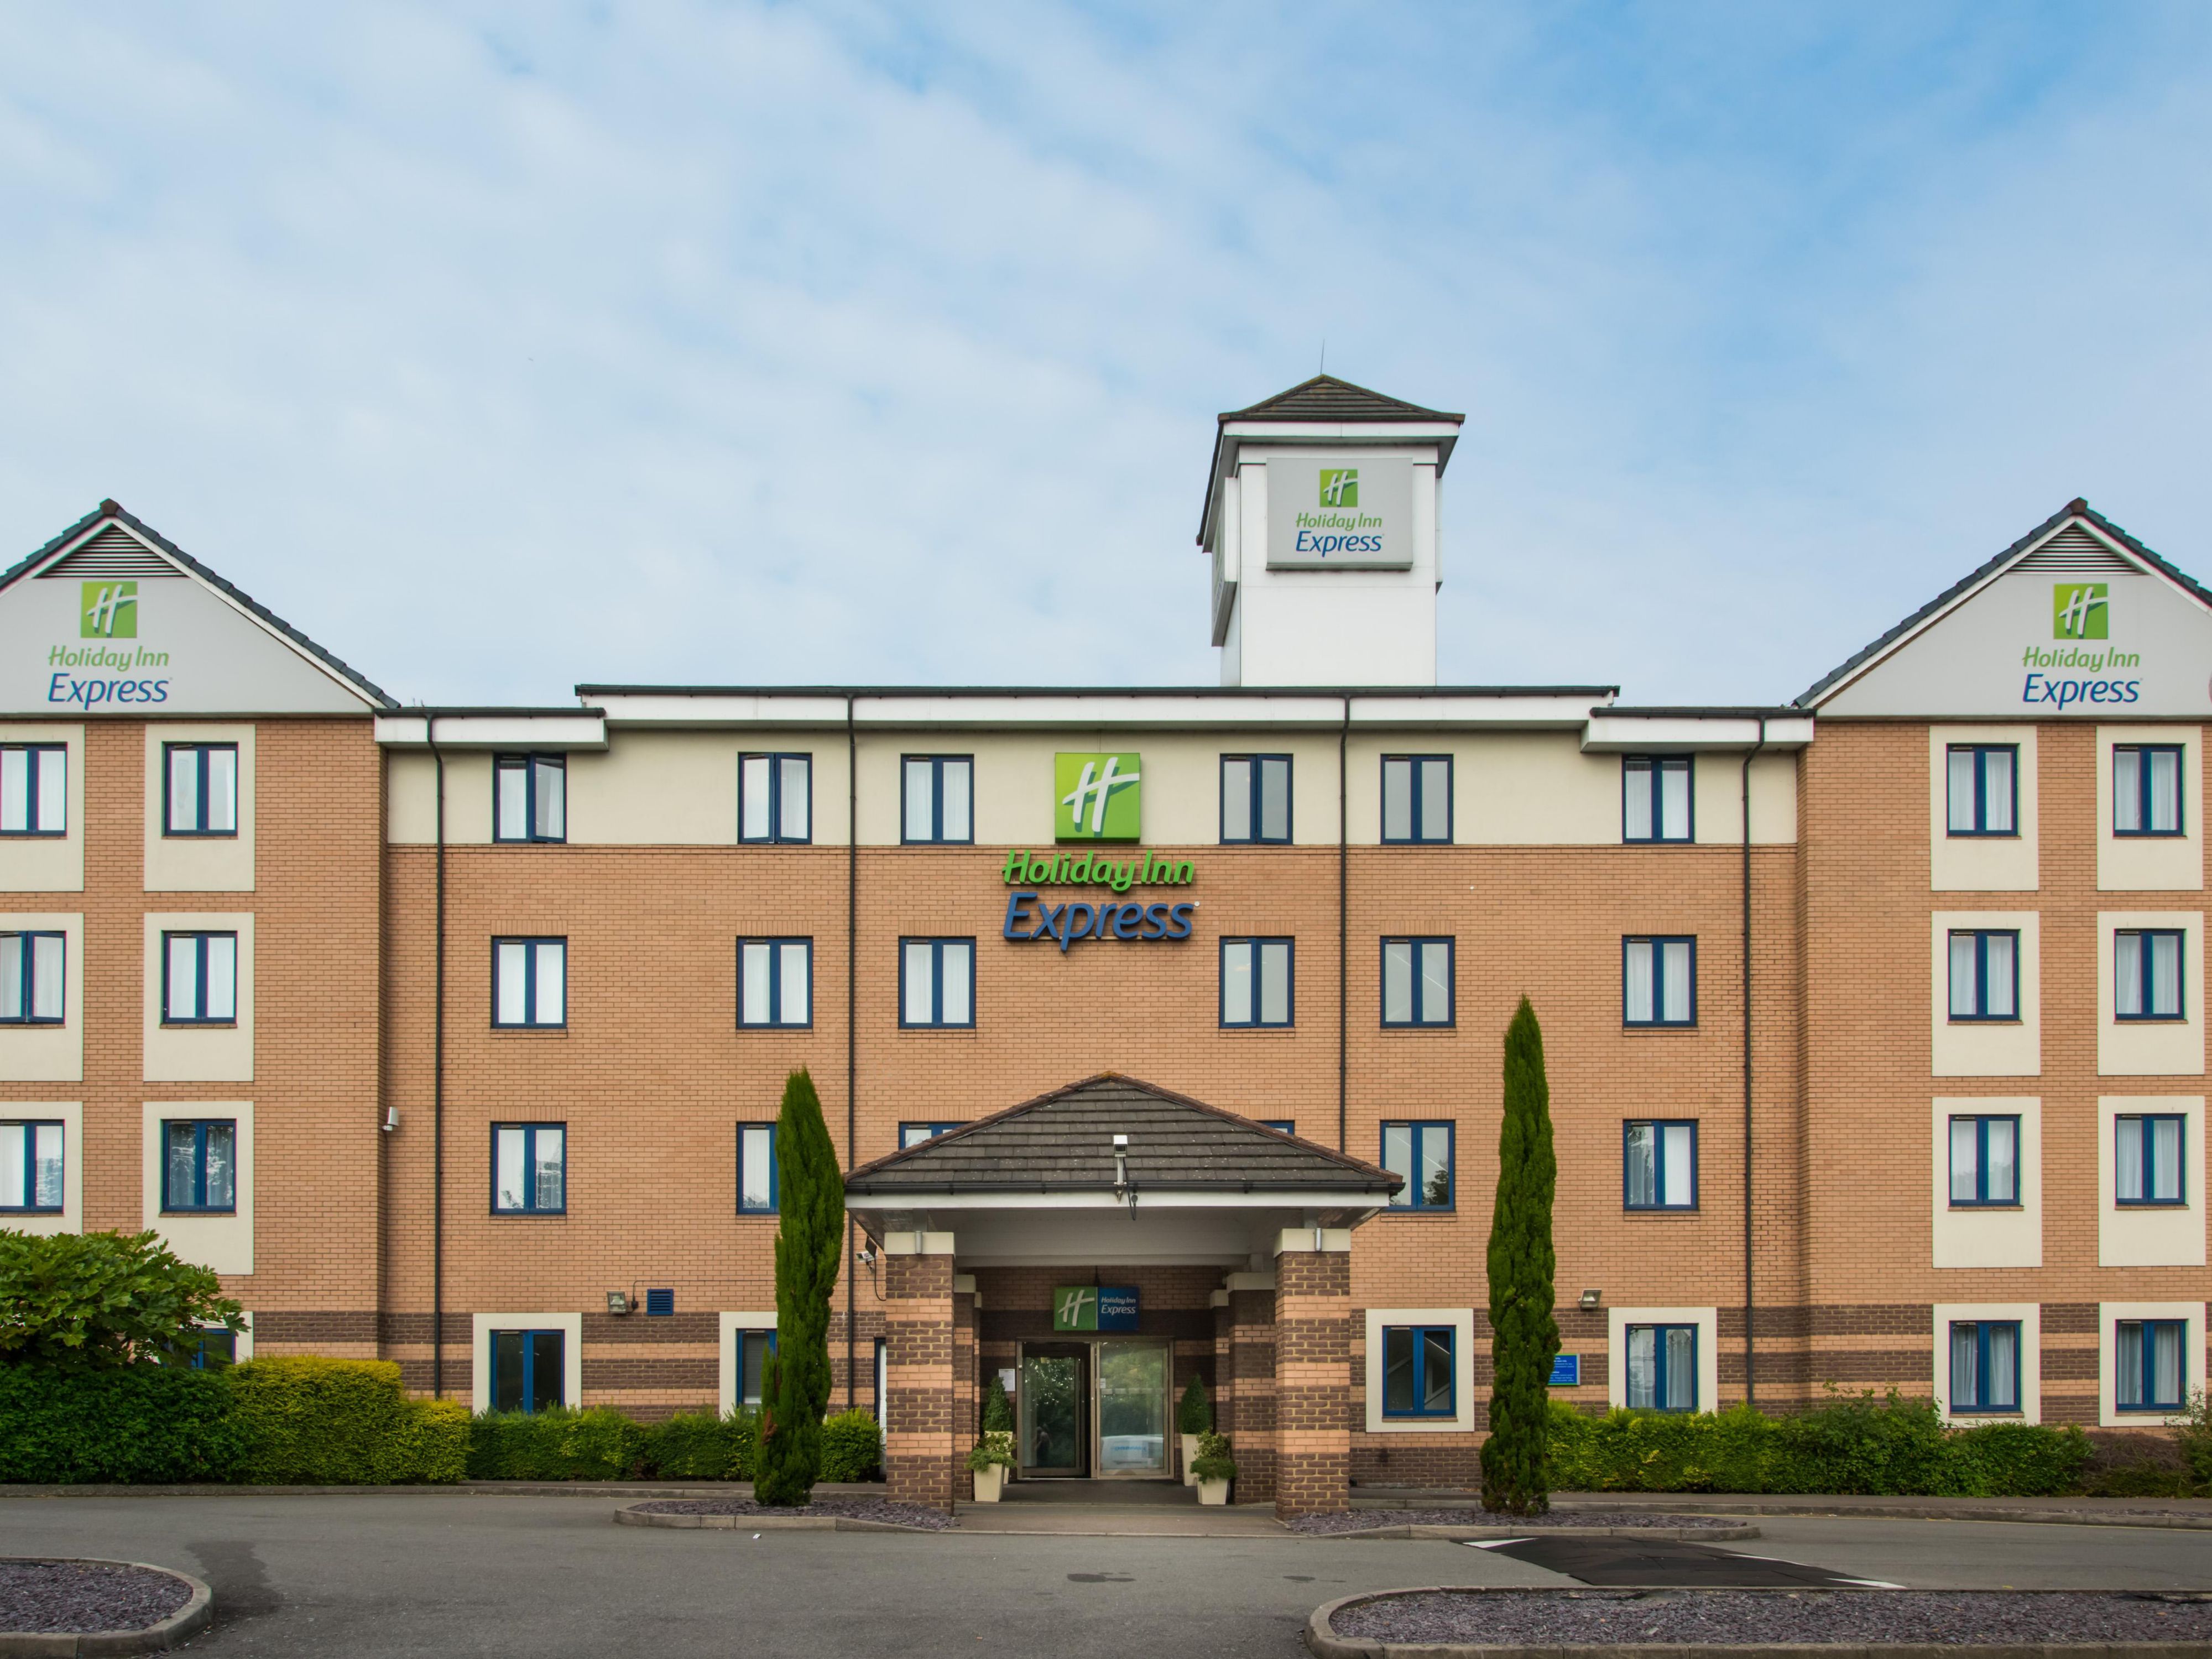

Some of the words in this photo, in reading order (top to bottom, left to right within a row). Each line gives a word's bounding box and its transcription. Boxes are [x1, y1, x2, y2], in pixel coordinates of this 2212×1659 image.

[1323, 471, 1358, 505] H
[1296, 513, 1356, 531] Holiday
[1358, 513, 1382, 528] Inn
[1296, 531, 1382, 557] Express
[87, 585, 138, 634] H
[2059, 587, 2108, 635] H
[48, 645, 132, 672] Holiday
[135, 646, 169, 666] Inn
[2022, 646, 2104, 672] Holiday
[2107, 647, 2140, 667] Inn
[48, 673, 169, 711] Express
[2022, 674, 2140, 711] Express
[1062, 757, 1140, 832] H
[1001, 849, 1136, 894] Holiday
[1141, 849, 1194, 884] Inn
[1003, 892, 1194, 952] Express
[1058, 1290, 1095, 1327] H
[1101, 1296, 1125, 1305] Holiday
[1101, 1305, 1136, 1316] Express
